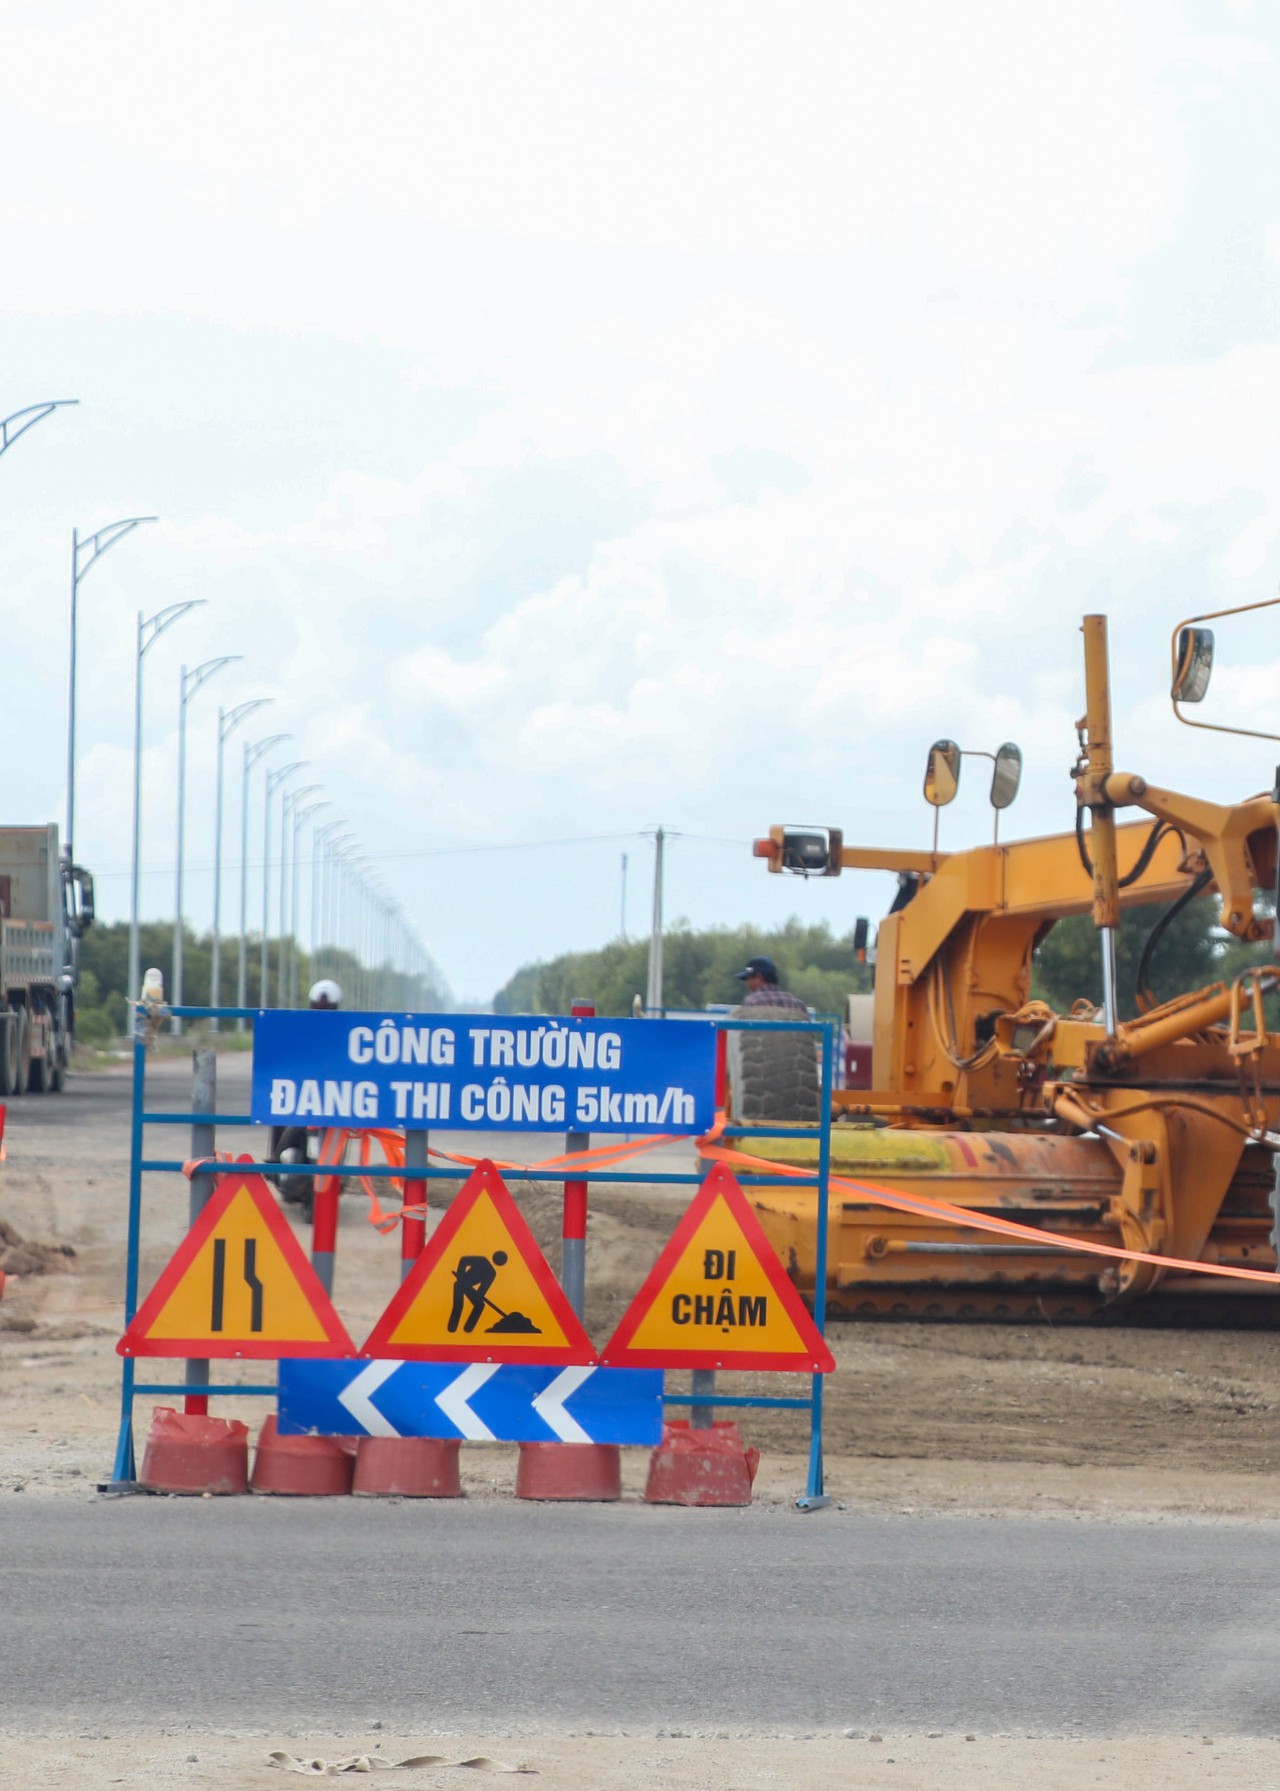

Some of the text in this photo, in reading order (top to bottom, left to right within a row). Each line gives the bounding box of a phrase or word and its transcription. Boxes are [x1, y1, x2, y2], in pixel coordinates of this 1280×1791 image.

[347, 1018, 621, 1070] CÔNG TRƯỜNG
[270, 1076, 696, 1125] ĐANG THI CÔNG 5km/h
[703, 1249, 736, 1281] ĐI
[672, 1288, 767, 1333] CHẬM
